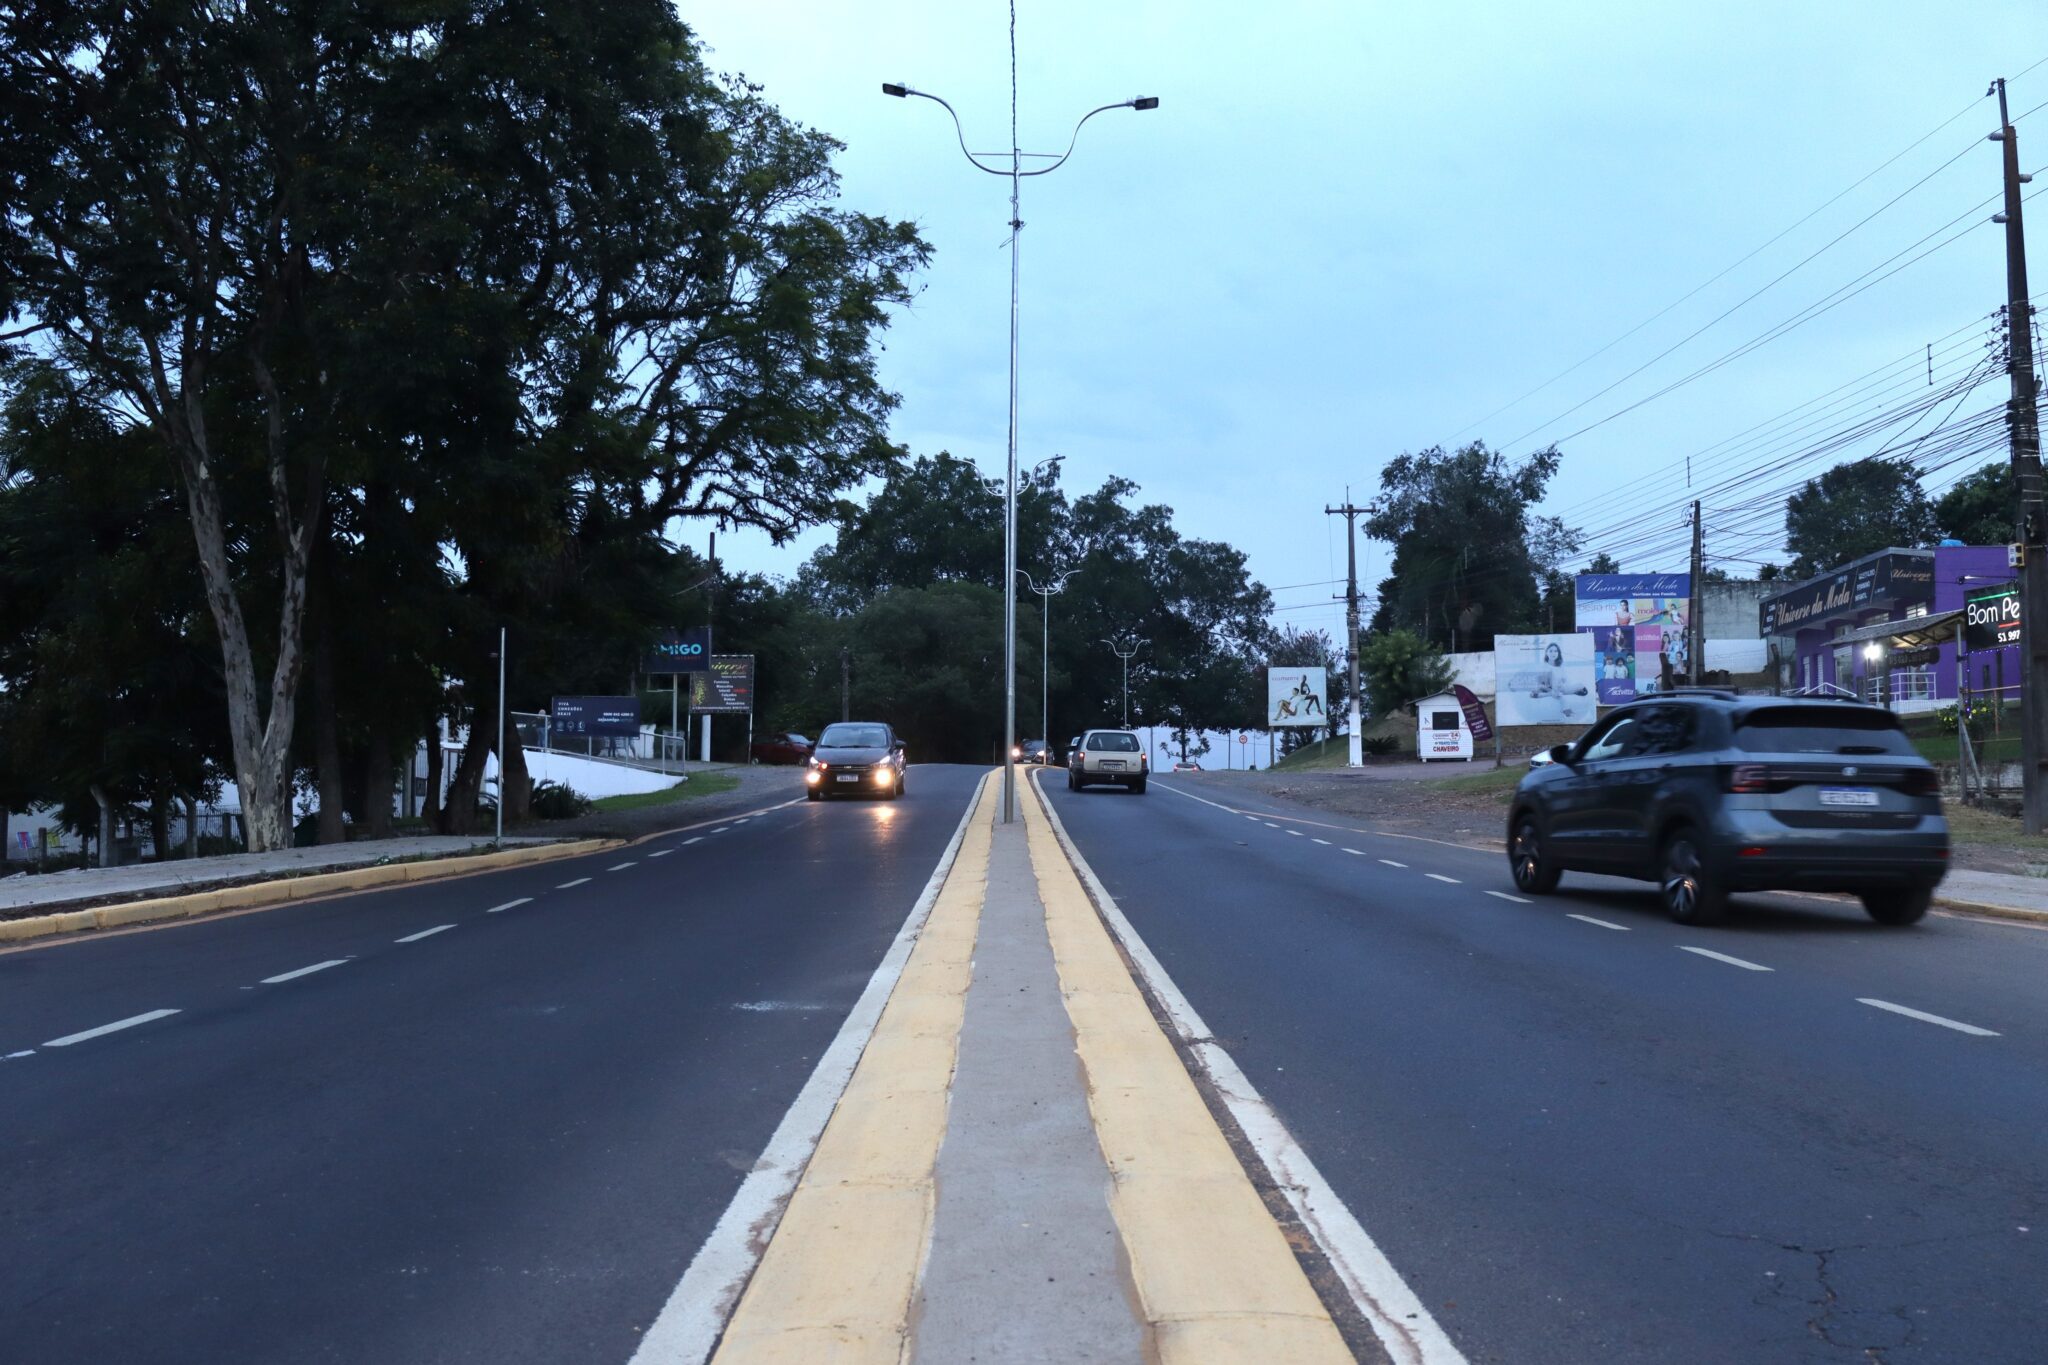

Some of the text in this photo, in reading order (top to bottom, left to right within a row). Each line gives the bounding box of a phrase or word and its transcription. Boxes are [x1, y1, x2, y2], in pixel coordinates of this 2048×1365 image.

[1777, 582, 1851, 626] Universe da Moda
[1967, 603, 1999, 626] Bom
[1997, 629, 2021, 643] 51 997
